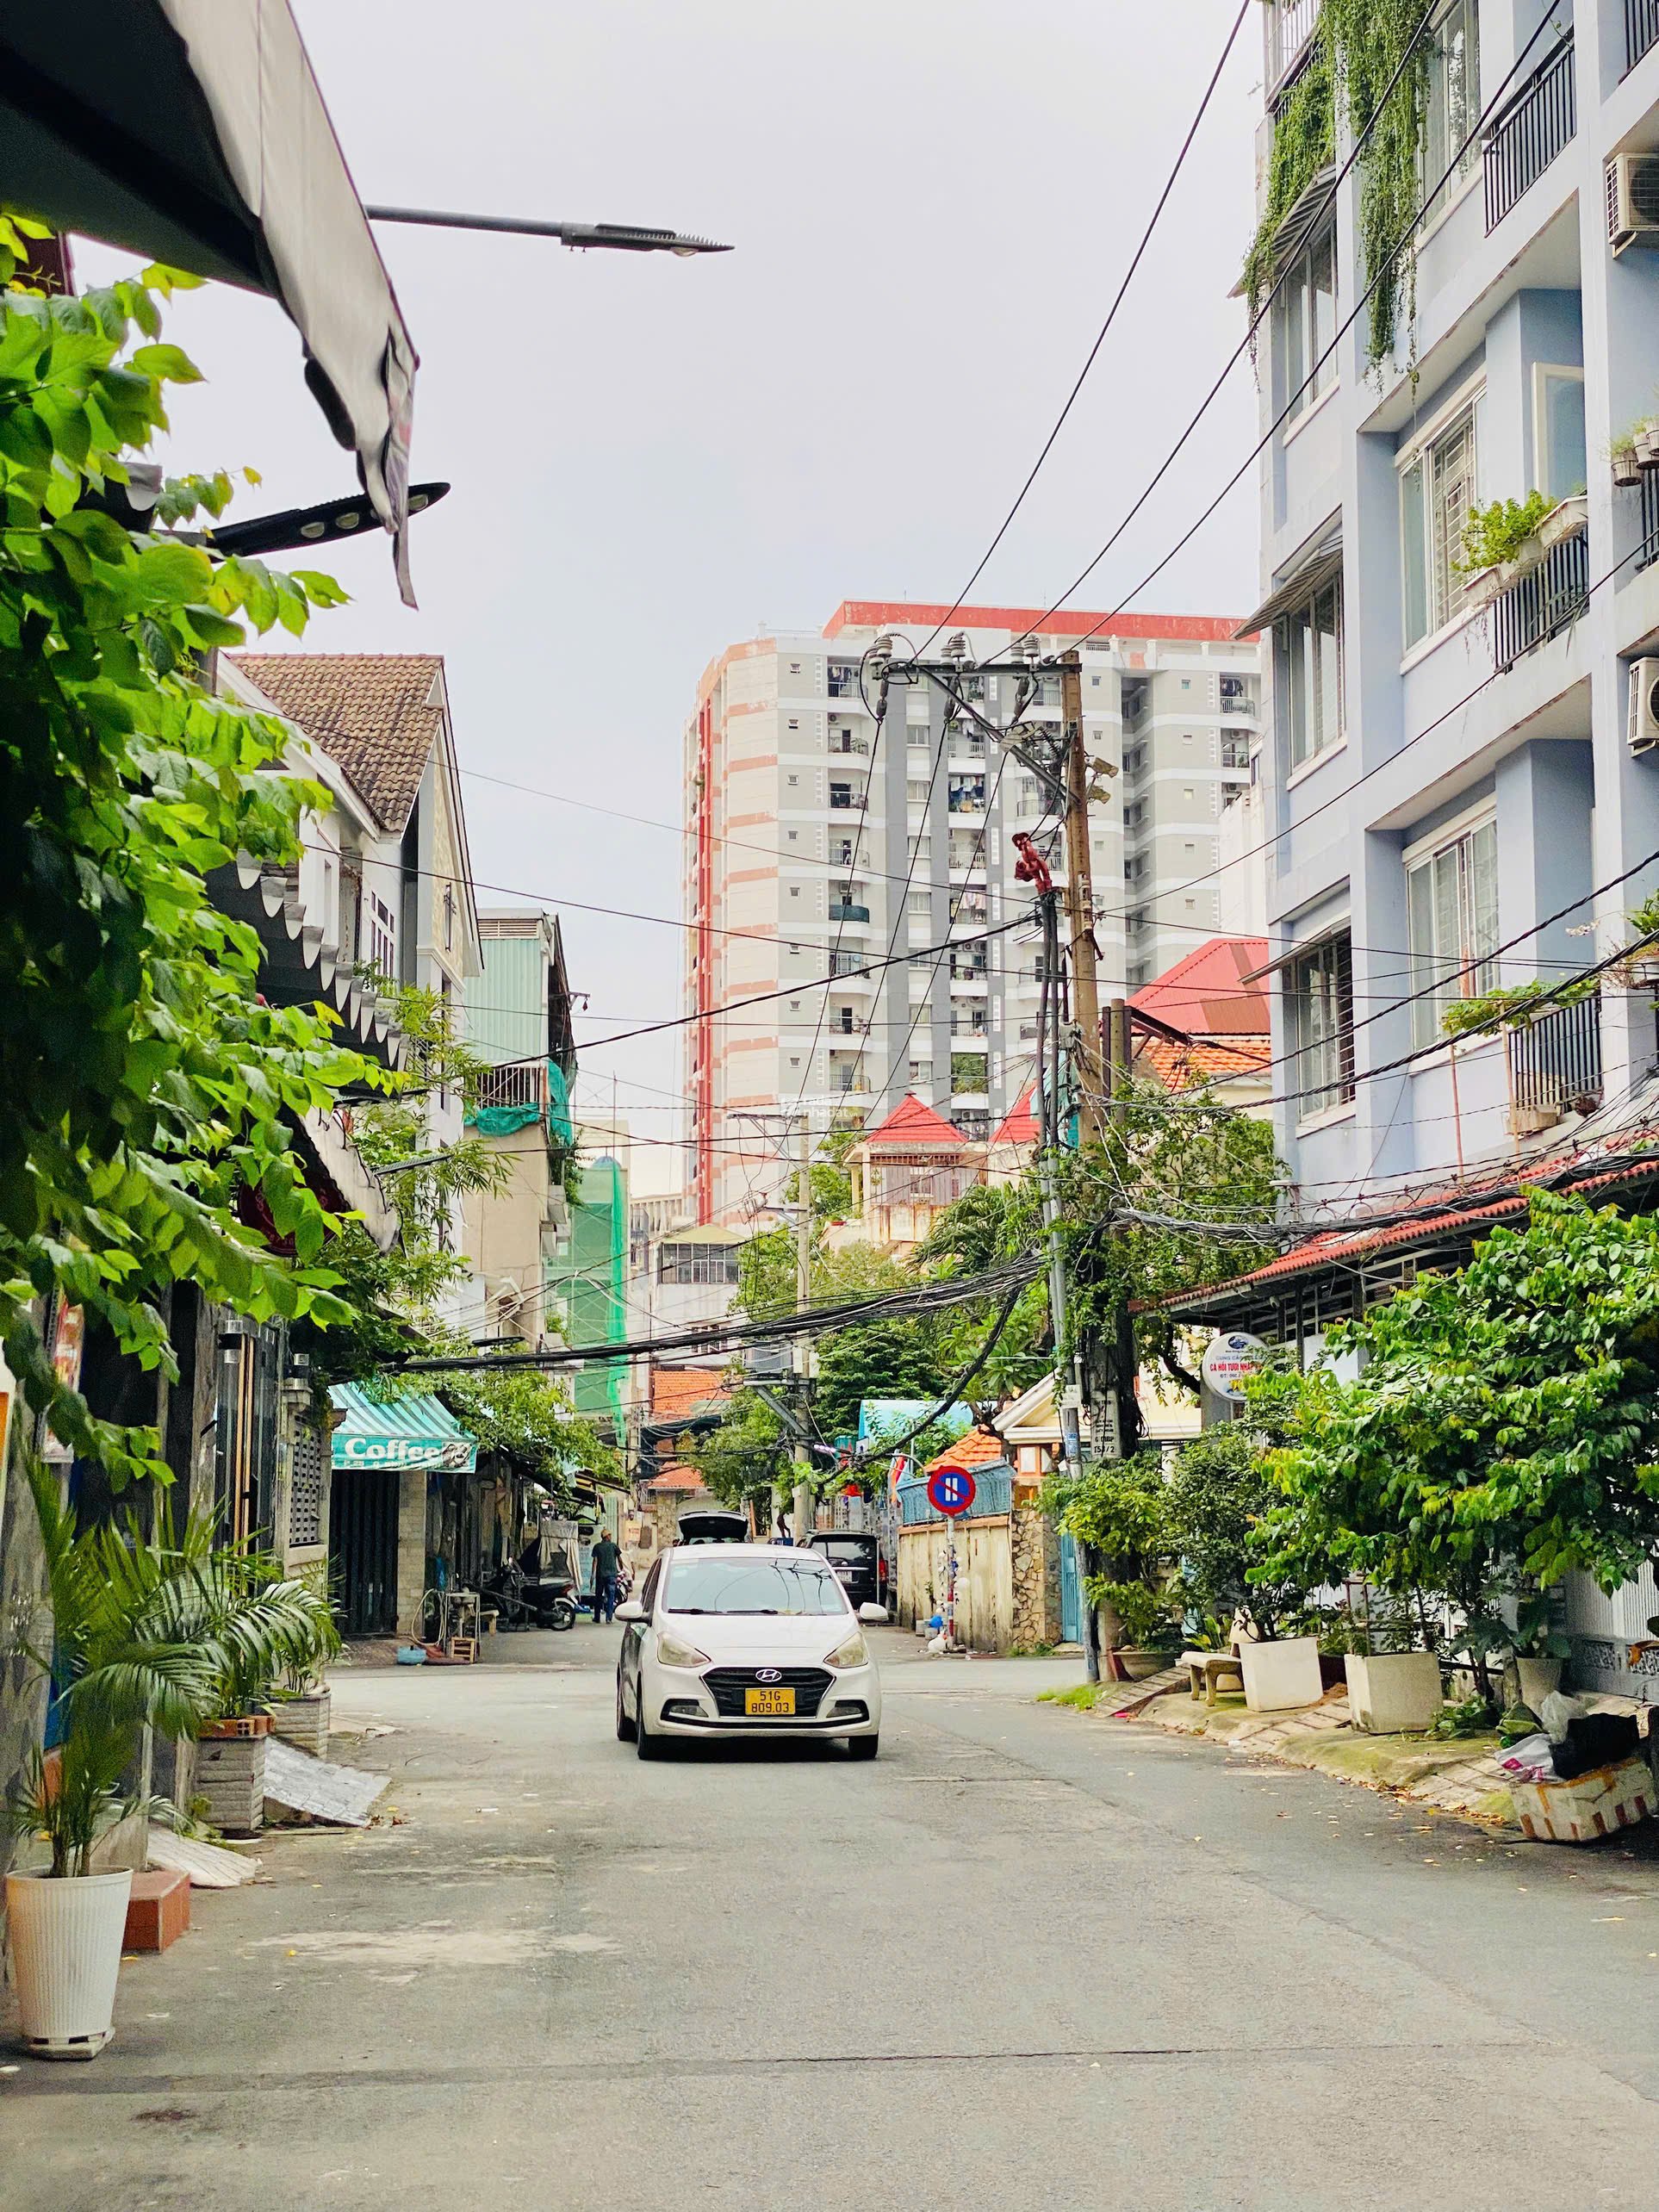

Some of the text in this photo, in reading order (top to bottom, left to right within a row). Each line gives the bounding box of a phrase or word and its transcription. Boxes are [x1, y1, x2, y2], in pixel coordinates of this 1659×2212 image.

[345, 1438, 441, 1460] Coffee
[760, 1691, 780, 1700] 51G
[751, 1703, 789, 1712] 809.03
